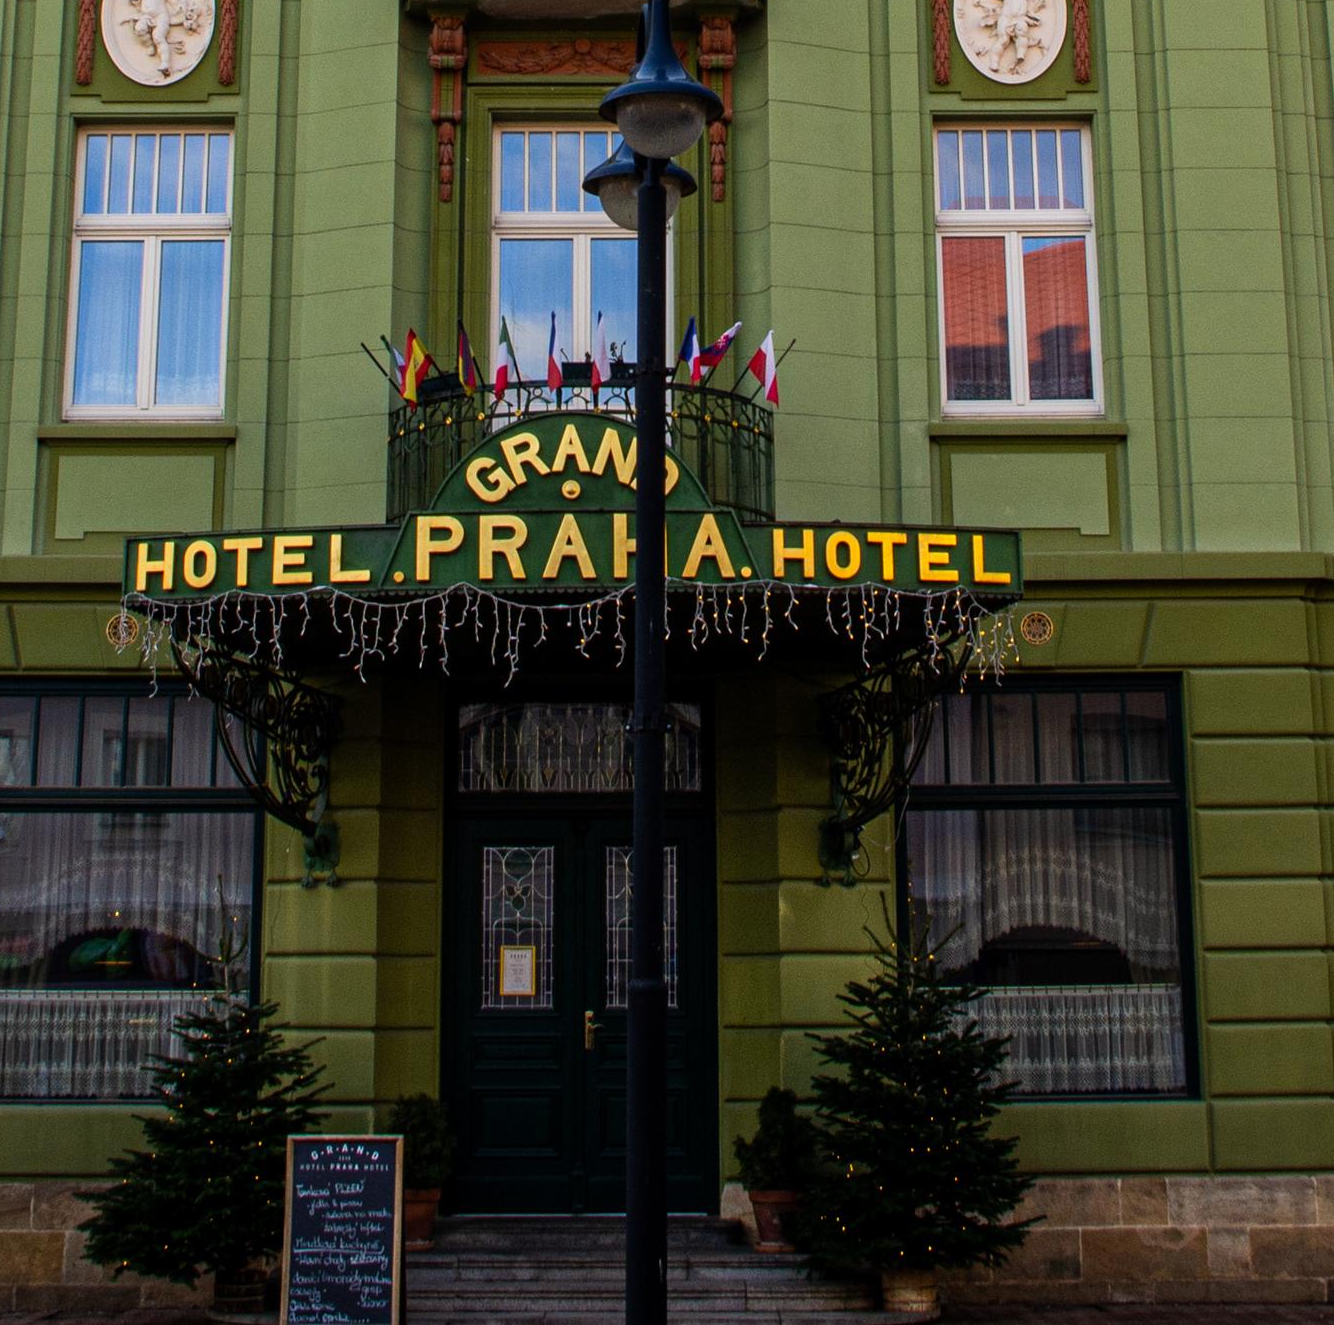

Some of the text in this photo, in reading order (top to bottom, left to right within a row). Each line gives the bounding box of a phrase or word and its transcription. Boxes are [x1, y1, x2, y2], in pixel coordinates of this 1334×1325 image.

[135, 533, 371, 592] HOTEL
[771, 528, 1012, 584] HOTEL
[330, 1163, 359, 1171] PRAHA
